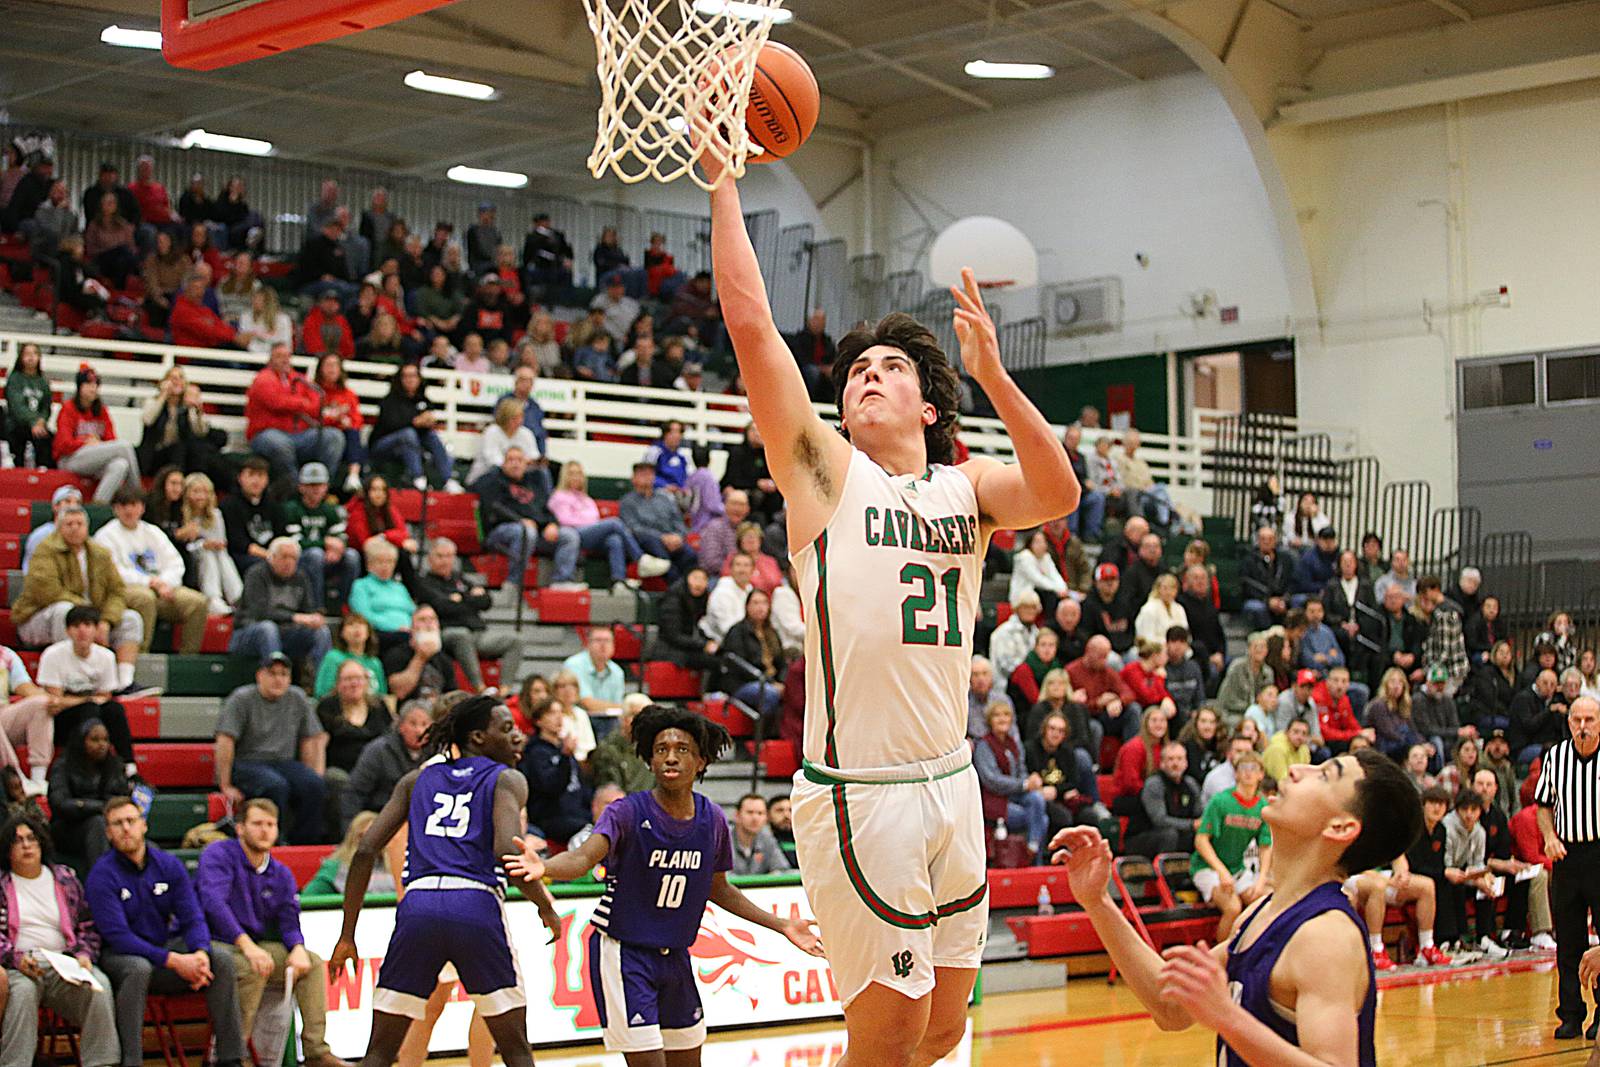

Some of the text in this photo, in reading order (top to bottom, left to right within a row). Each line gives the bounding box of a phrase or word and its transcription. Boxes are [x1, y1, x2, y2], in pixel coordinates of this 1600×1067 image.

[900, 562, 962, 647] 21
[425, 791, 473, 838] 25
[648, 849, 702, 870] PLANO
[656, 874, 687, 908] 10
